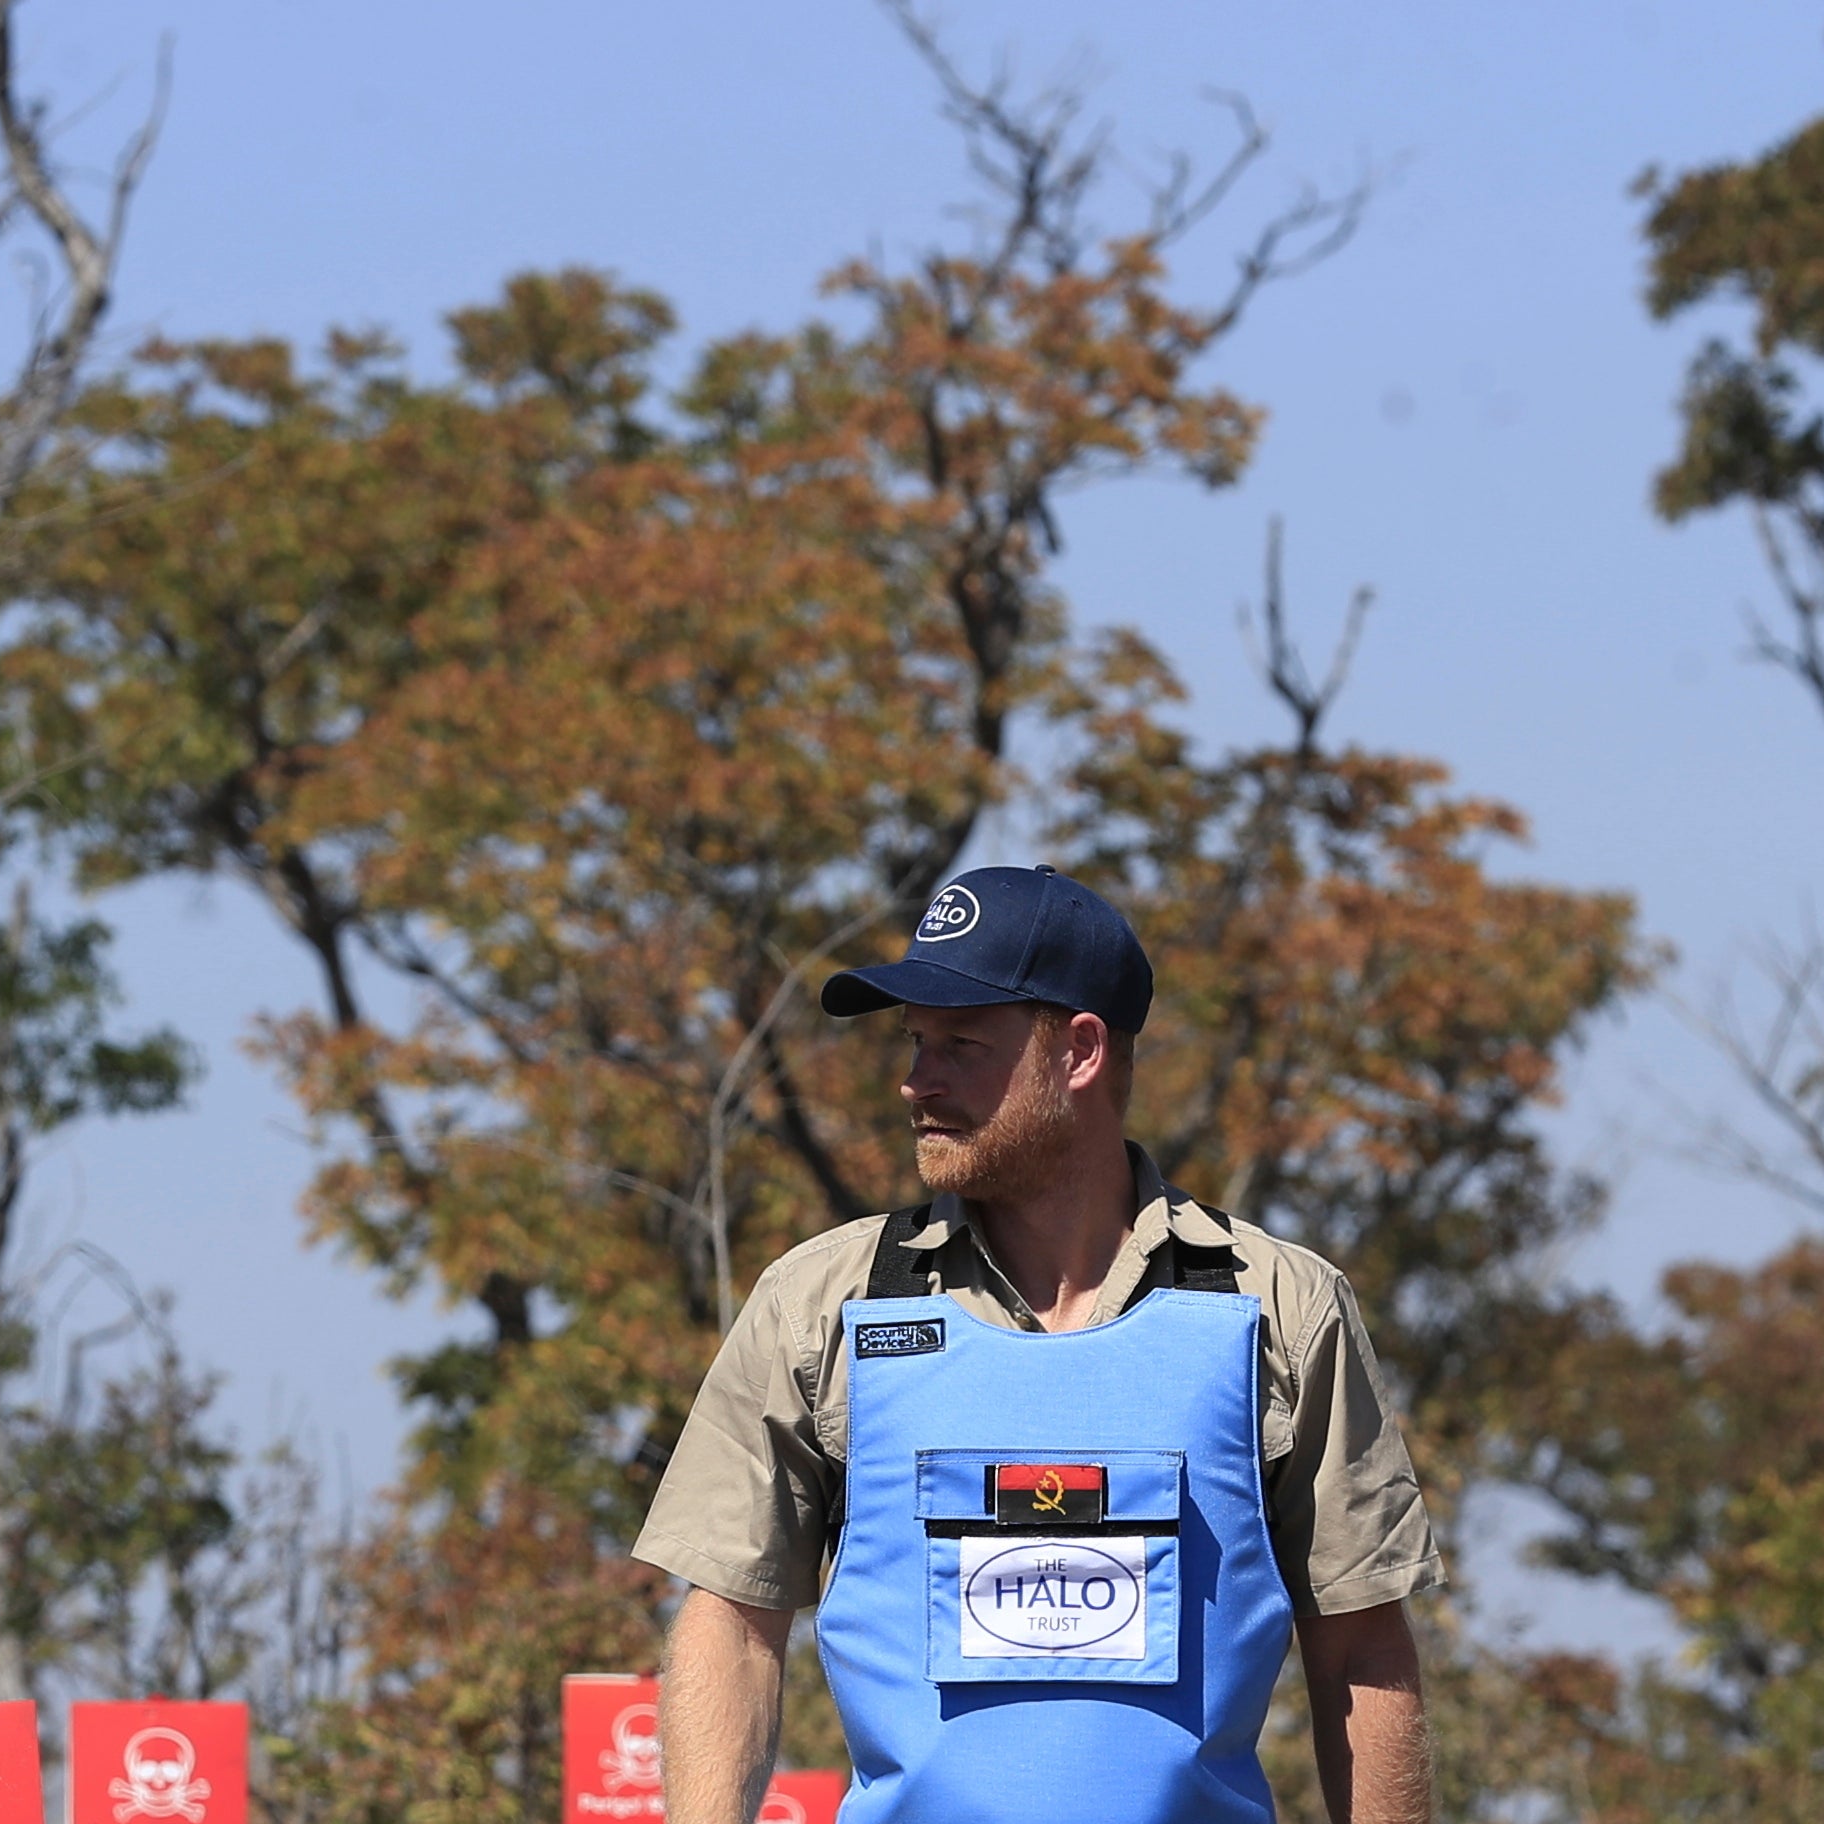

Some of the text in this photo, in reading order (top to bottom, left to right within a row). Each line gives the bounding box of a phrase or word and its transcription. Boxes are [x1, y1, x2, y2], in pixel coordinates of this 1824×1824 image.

[859, 1325, 914, 1339] Security
[858, 1337, 913, 1349] Devices
[1034, 1557, 1067, 1573] THE
[994, 1576, 1117, 1611] HALO
[1026, 1617, 1083, 1632] TRUST
